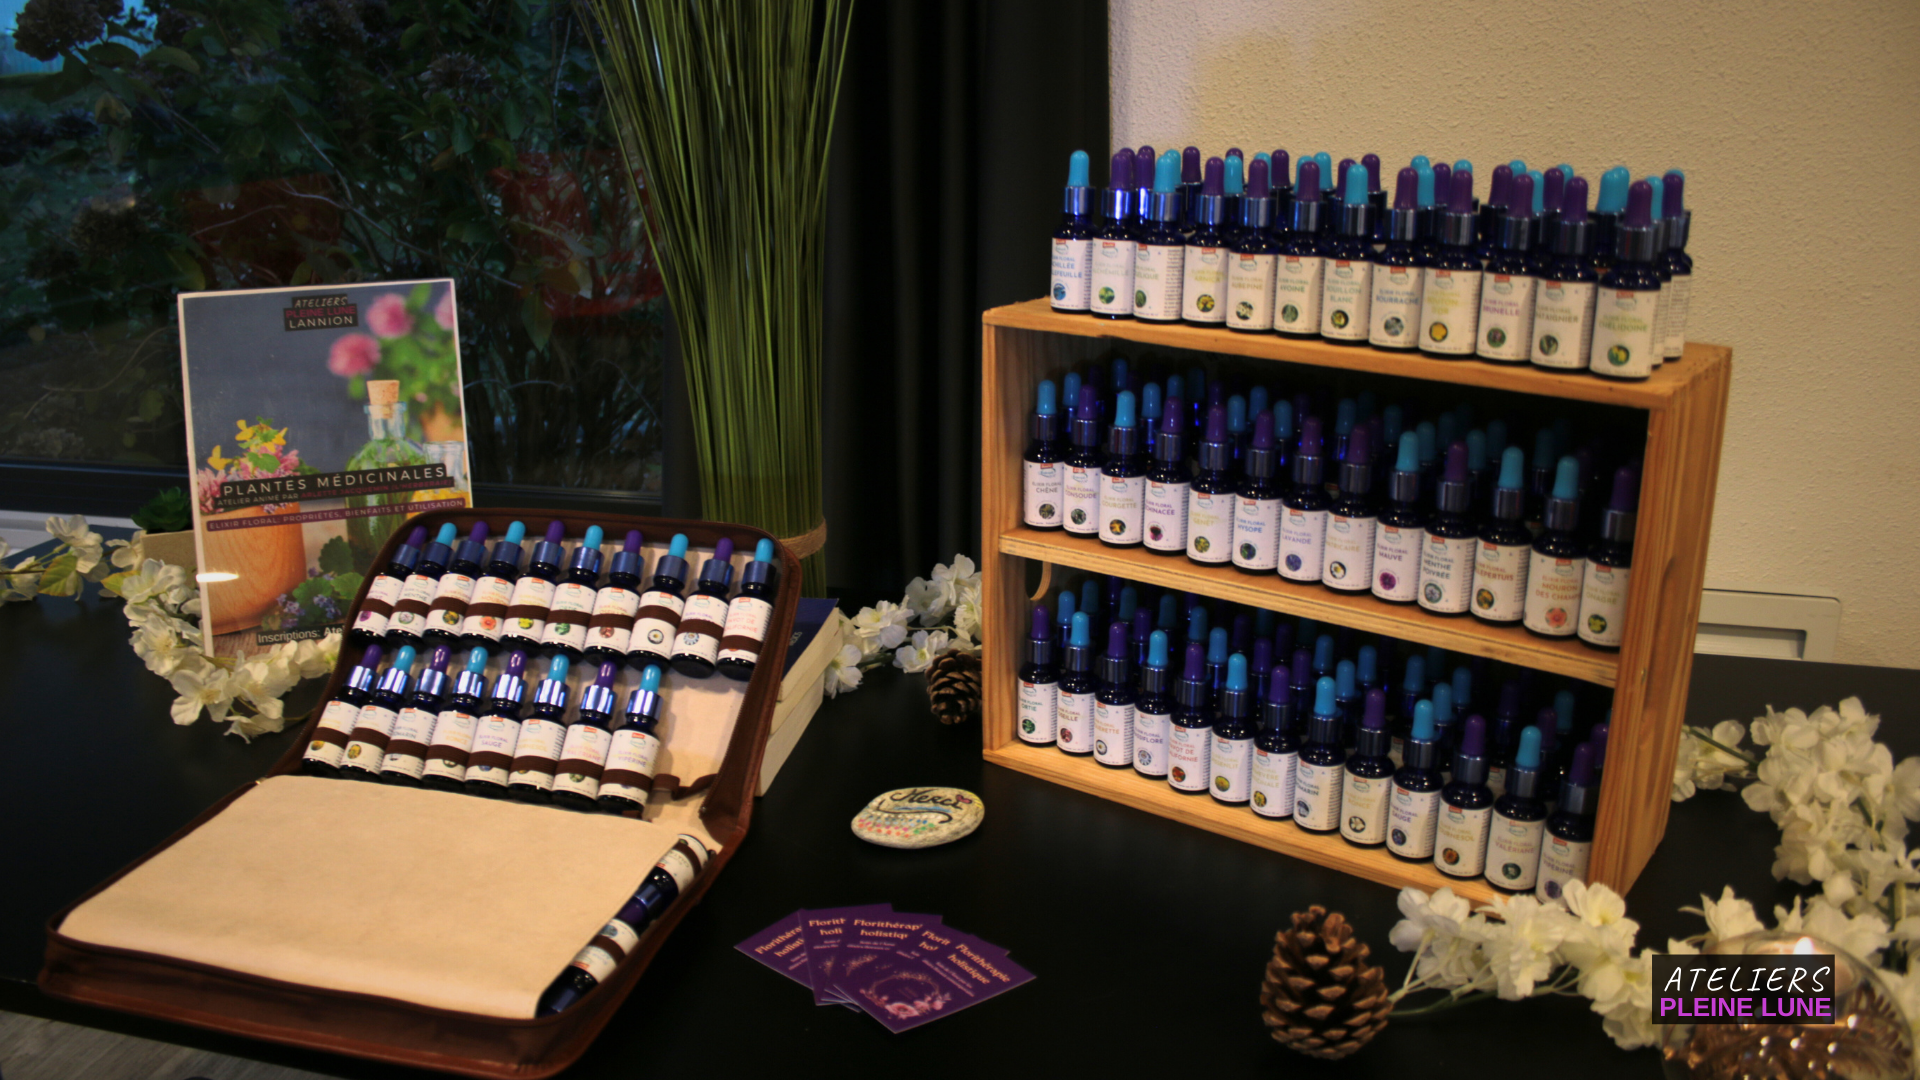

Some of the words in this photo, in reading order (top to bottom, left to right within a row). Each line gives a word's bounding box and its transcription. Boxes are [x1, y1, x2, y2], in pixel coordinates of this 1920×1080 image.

[1326, 285, 1360, 293] BOUILLON
[294, 296, 348, 308] ATELIERS
[1330, 295, 1352, 303] BLANC
[1376, 295, 1419, 304] BOURRACHE
[286, 308, 324, 318] PLEINE
[327, 305, 356, 315] LUNE
[289, 316, 353, 328] LANNION
[224, 479, 306, 496] PLANTES
[317, 467, 444, 488] MÉDICINALES
[218, 496, 251, 506] ATELIER
[253, 493, 280, 503] ANIMÉ
[282, 492, 299, 500] PAR
[301, 489, 337, 499] ARLETTE
[340, 485, 389, 495] JACQUEMIN
[1065, 490, 1097, 499] CONSOUDE
[1102, 500, 1137, 509] COURGETTE
[210, 521, 240, 530] ELIXIR
[345, 506, 392, 516] BIENFAITS
[394, 504, 405, 512] ET
[408, 500, 463, 511] UTILISATION
[1238, 524, 1262, 533] HYSOPE
[1282, 534, 1312, 545] LAVANDE
[1379, 551, 1402, 561] MAUVE
[1435, 555, 1454, 563] FLORAL
[1424, 559, 1451, 571] MENTHE
[1486, 565, 1506, 573] FLORAL
[1423, 566, 1450, 579] POIVRÉE
[1542, 583, 1578, 591] MOURON
[404, 593, 427, 601] MENTHE
[1536, 589, 1550, 598] DES
[1552, 591, 1580, 601] CHAMP
[258, 629, 320, 644] Inscriptions:
[323, 625, 345, 637] Ate
[1021, 703, 1036, 711] ORTIE
[481, 740, 502, 749] SAUGE
[492, 735, 508, 743] FLORAL
[632, 753, 649, 761] FLORAL
[890, 789, 963, 810] Merci
[1348, 798, 1370, 809] RONCE
[1392, 809, 1411, 823] SAUGE
[1401, 807, 1418, 817] FLORAL
[854, 919, 923, 931] Florithérap
[956, 943, 1010, 982] Florithérapie
[947, 954, 990, 984] holistique
